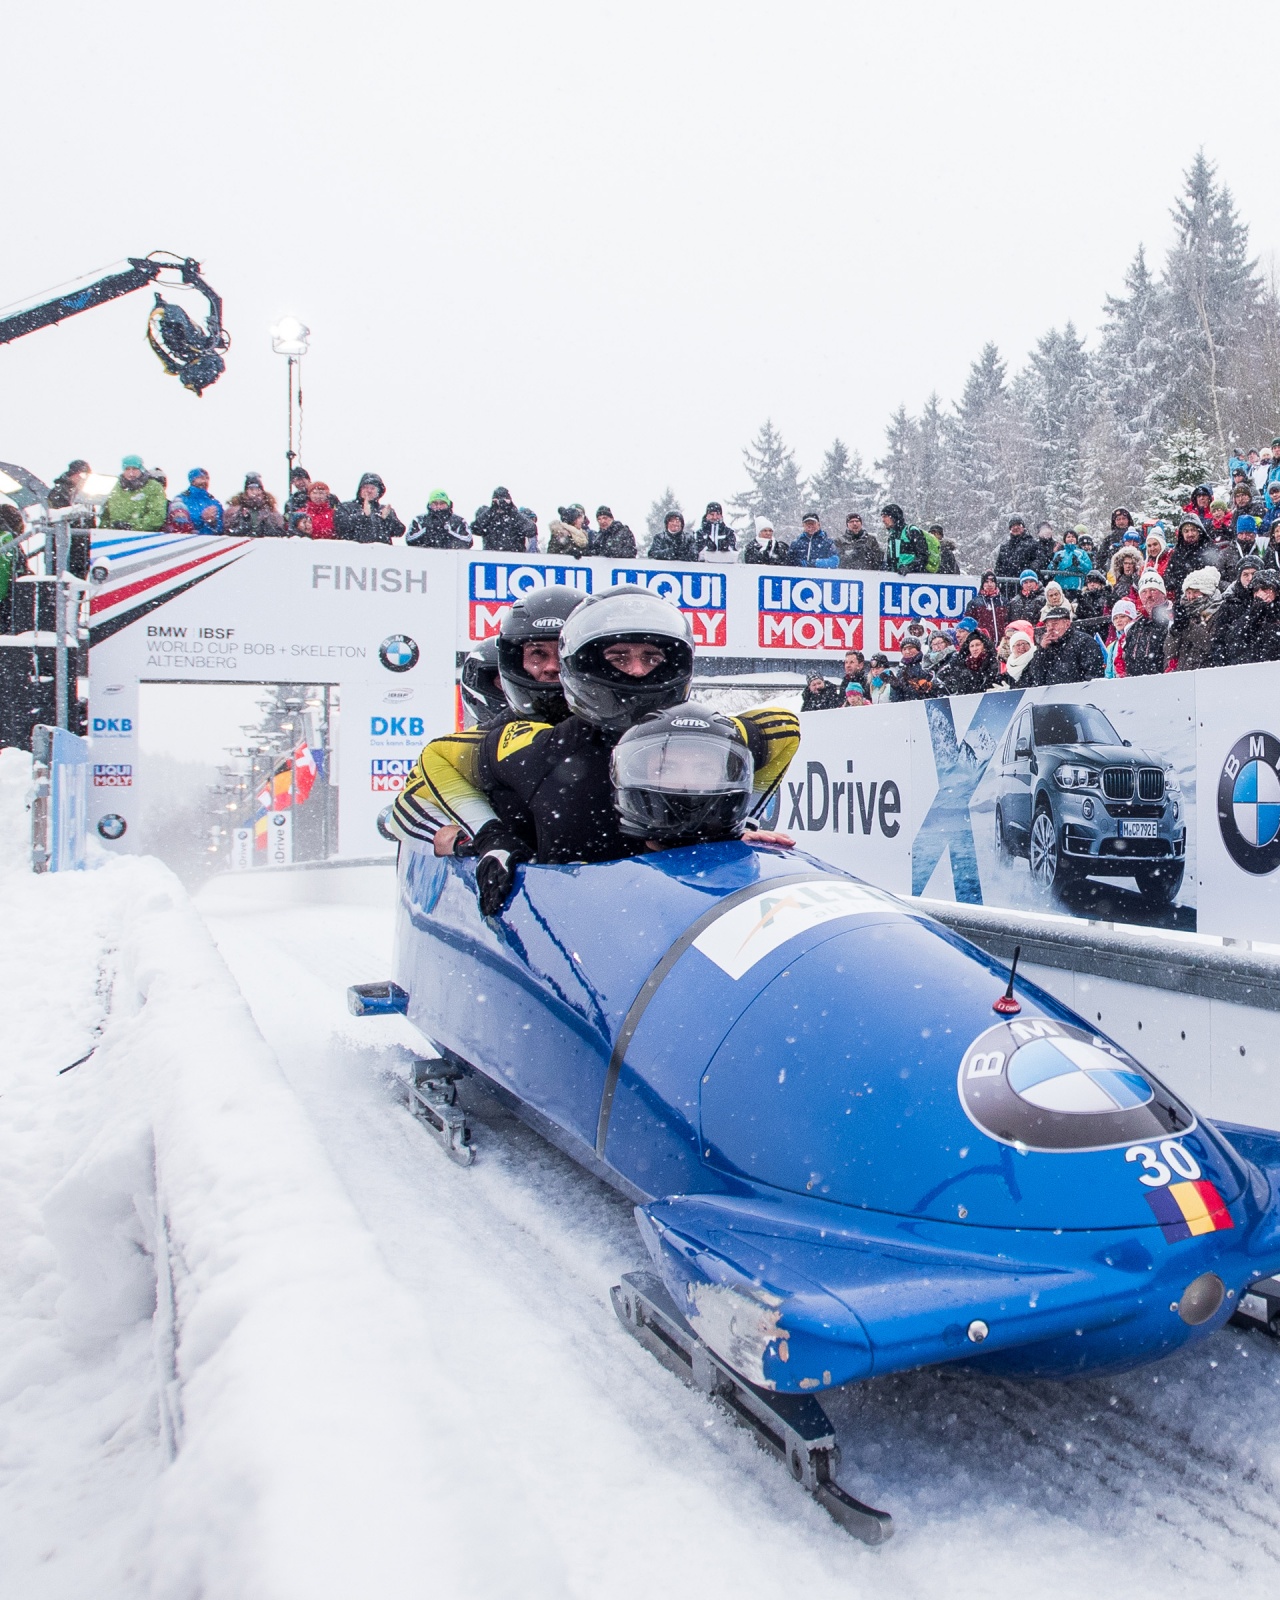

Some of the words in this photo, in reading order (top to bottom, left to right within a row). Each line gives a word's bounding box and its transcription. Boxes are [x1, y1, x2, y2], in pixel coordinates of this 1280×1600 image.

[312, 564, 428, 594] FINISH
[763, 578, 859, 613] LIQUI
[884, 585, 973, 619] LIQUI
[147, 626, 188, 638] BMW
[199, 627, 235, 639] IBSF
[763, 615, 863, 648] MOLY
[146, 640, 204, 654] WORLD
[208, 641, 239, 655] CUP
[244, 643, 275, 656] BOB
[291, 644, 367, 658] SKELETON
[146, 655, 238, 669] ALTENBERG
[93, 718, 133, 732] DKB
[370, 716, 425, 736] DKB
[370, 738, 385, 746] Das
[405, 738, 423, 746] Bank
[95, 765, 132, 775] LIQUI
[373, 759, 418, 775] LIQU
[95, 776, 132, 786] MOLY
[373, 775, 408, 791] MO
[787, 759, 901, 839] xDrive
[1125, 1139, 1201, 1187] 30
